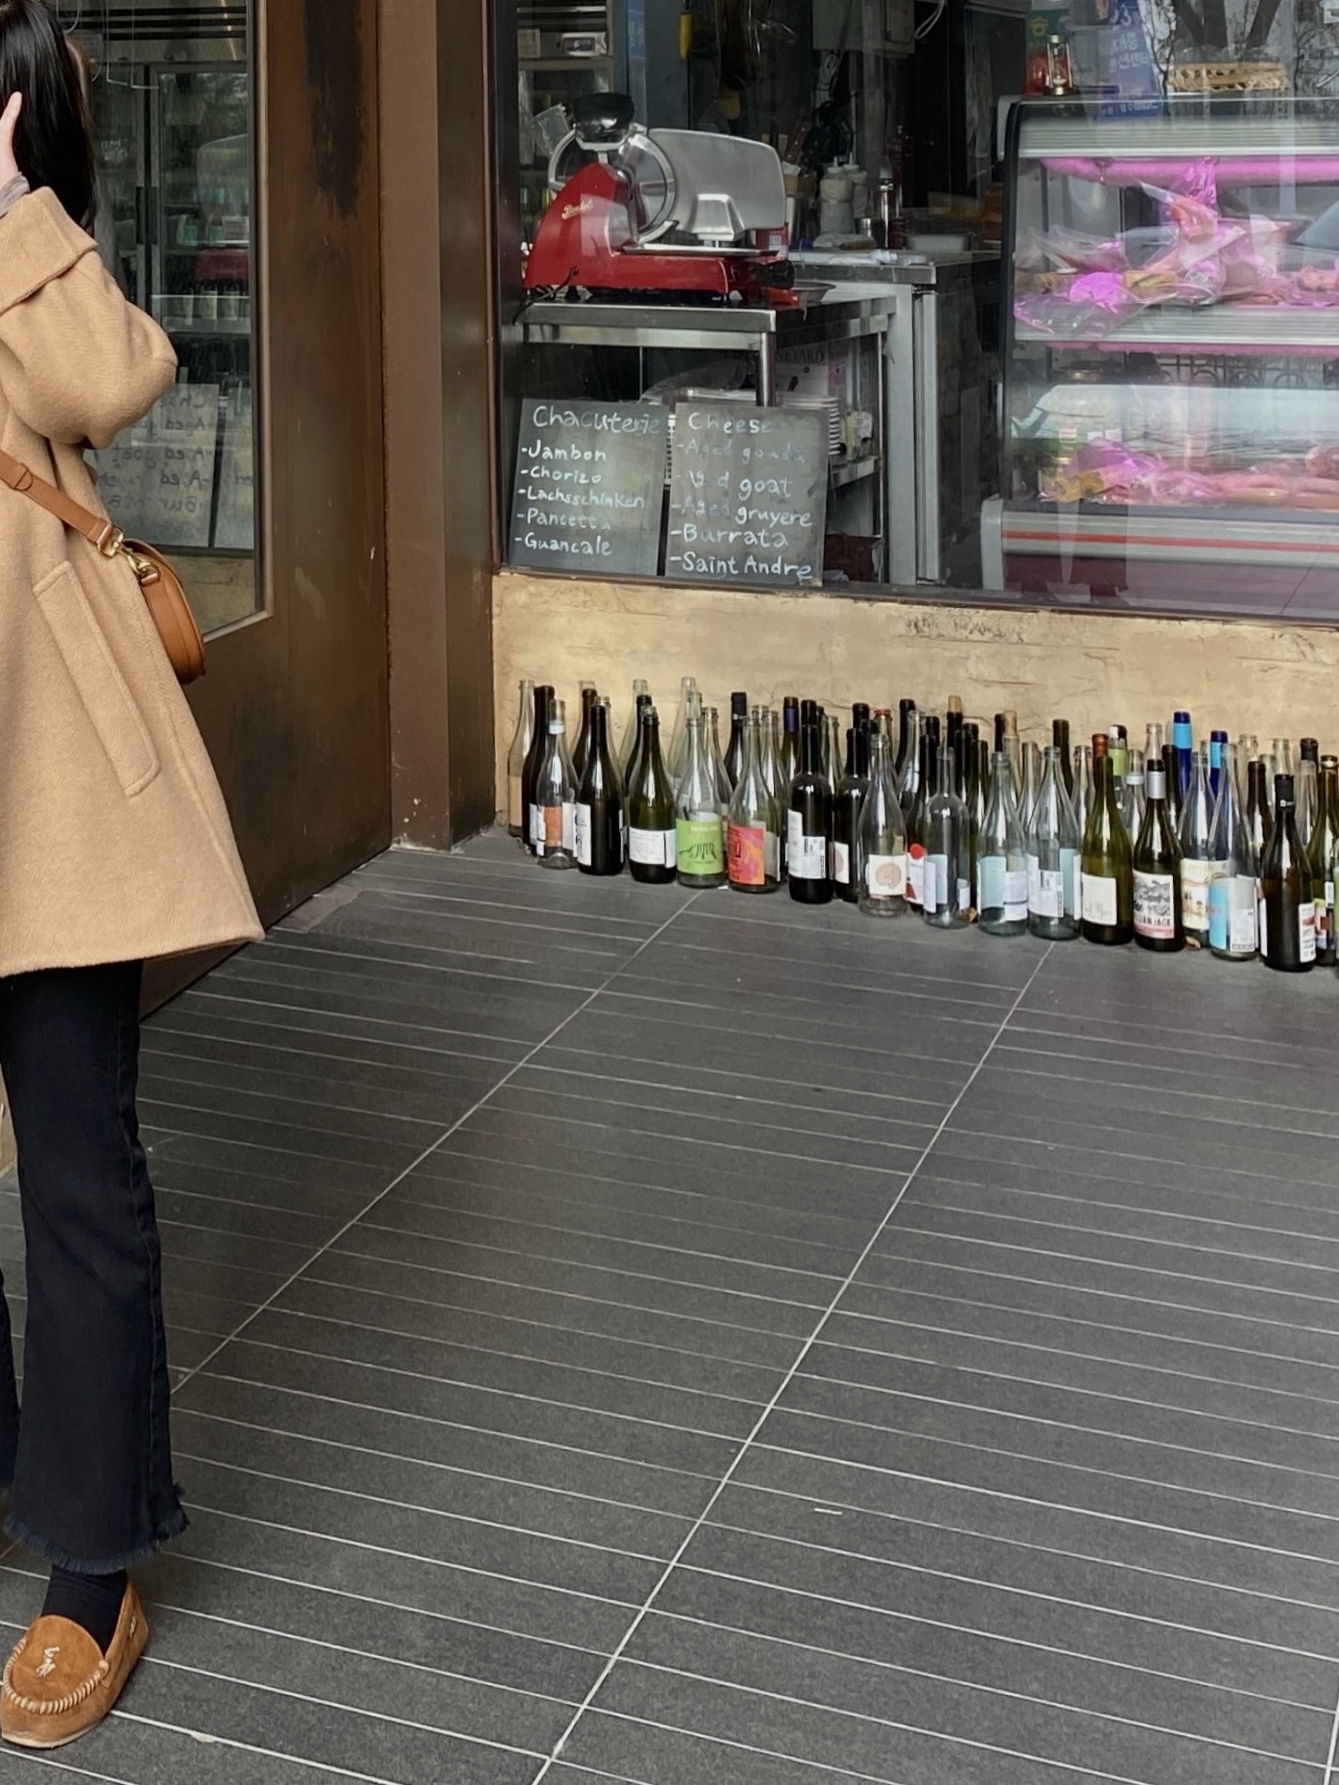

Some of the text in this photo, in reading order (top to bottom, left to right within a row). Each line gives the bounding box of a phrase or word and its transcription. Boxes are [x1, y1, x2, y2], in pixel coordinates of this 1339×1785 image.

[533, 405, 660, 434] Chacuterie
[688, 412, 773, 434] Cheese
[739, 476, 794, 501] goat
[735, 505, 813, 529] gruyere
[744, 555, 813, 579] Andre
